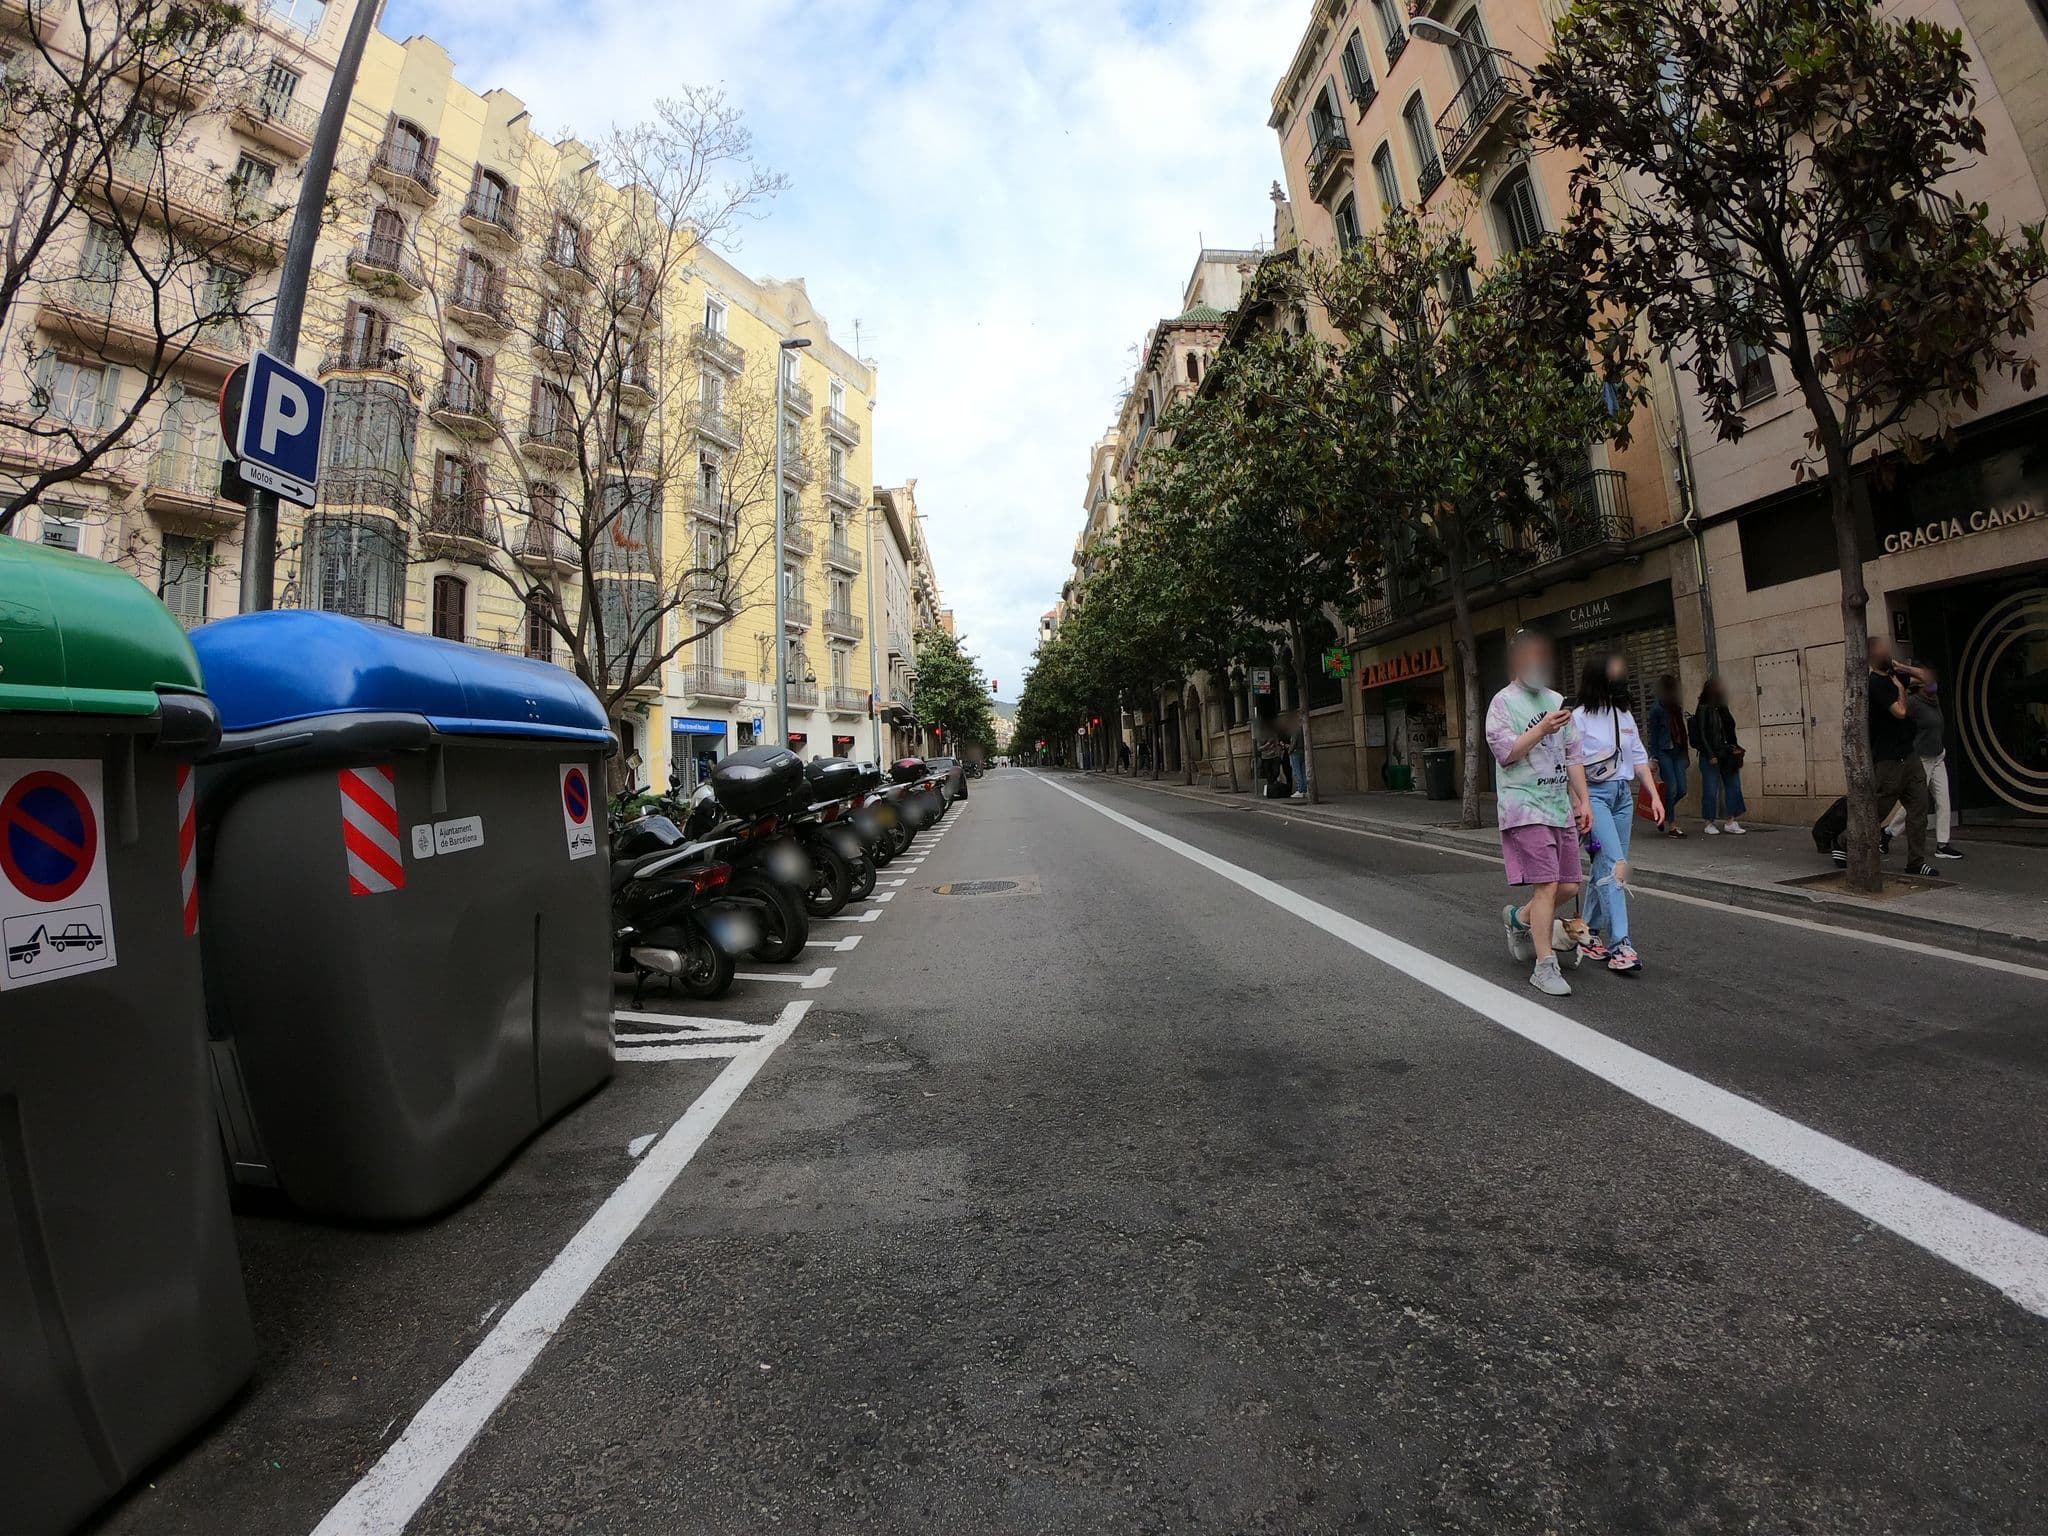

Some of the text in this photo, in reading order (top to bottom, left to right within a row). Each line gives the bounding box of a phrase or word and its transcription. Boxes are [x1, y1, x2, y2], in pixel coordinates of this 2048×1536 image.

[260, 371, 310, 455] P
[250, 467, 273, 485] Motos
[1884, 517, 1964, 553] GRACIA
[1570, 600, 1610, 621] CALMA
[1580, 617, 1603, 630] HOUSE
[440, 824, 472, 838] Ajuntament
[440, 834, 478, 848] de Barcelona
